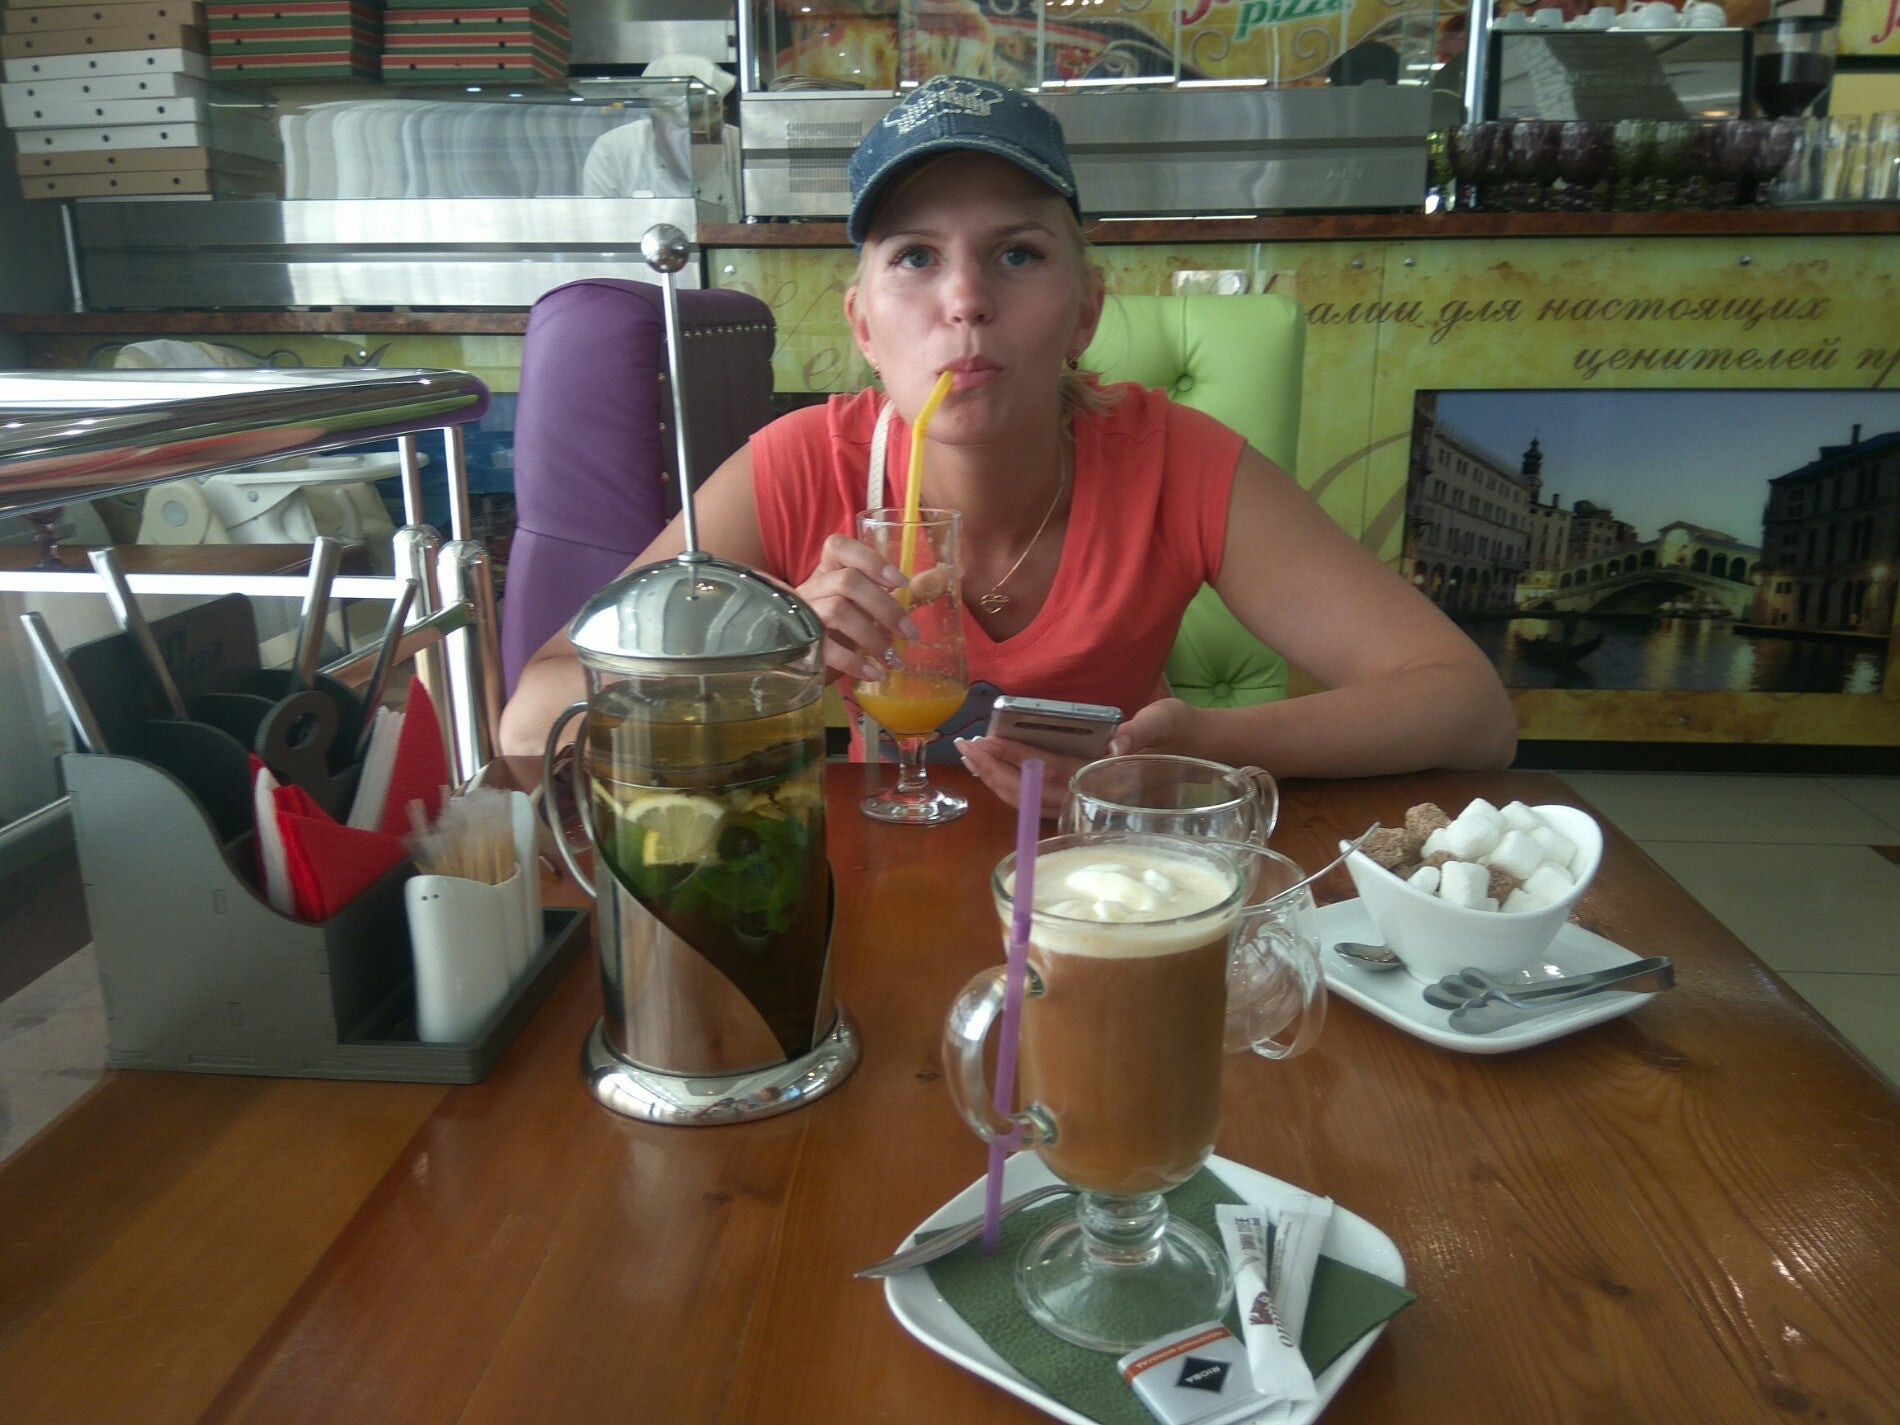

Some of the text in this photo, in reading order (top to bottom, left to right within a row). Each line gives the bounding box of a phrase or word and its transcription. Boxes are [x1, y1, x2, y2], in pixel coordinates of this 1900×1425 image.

[1429, 298, 1524, 346] для
[1536, 296, 1833, 332] настоящих
[1573, 335, 1843, 381] ценителей
[1185, 1365, 1221, 1383] RIOBA
